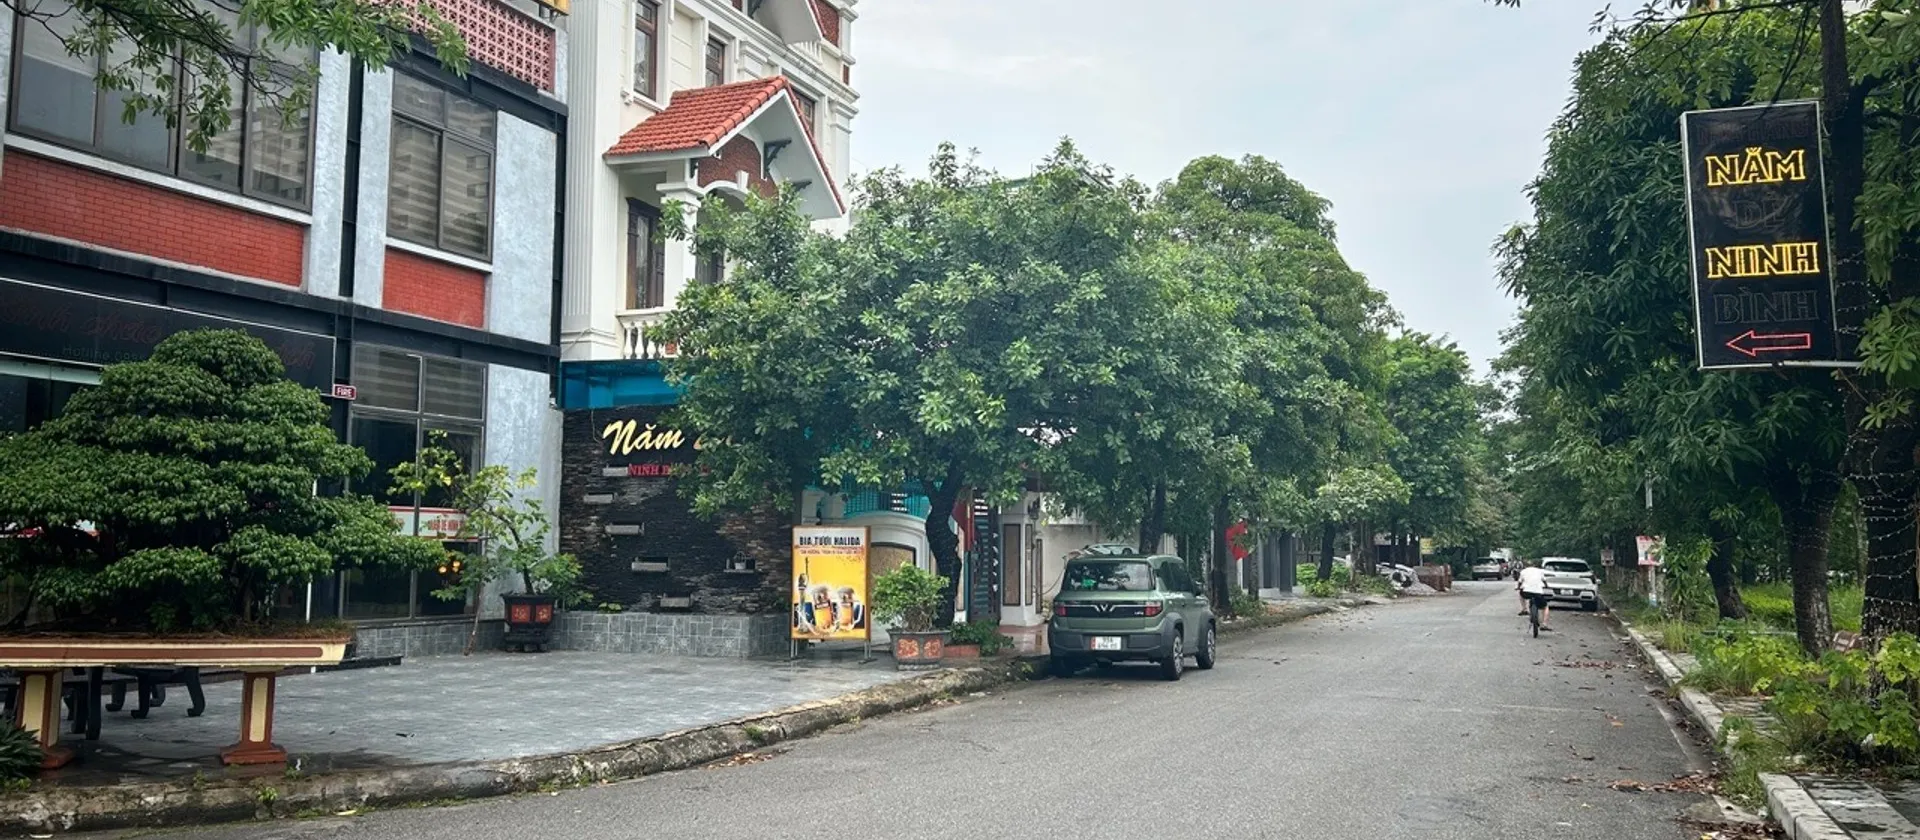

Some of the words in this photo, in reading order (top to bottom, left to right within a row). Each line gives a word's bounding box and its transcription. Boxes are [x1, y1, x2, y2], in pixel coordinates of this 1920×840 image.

[1705, 147, 1806, 186] NĂM
[1705, 242, 1820, 279] NINH
[1714, 286, 1820, 325] BÌNH
[336, 387, 354, 398] FIRE
[602, 418, 686, 457] Năm
[628, 463, 659, 476] NINH
[799, 536, 813, 546] BIA
[834, 536, 861, 546] HALIDA
